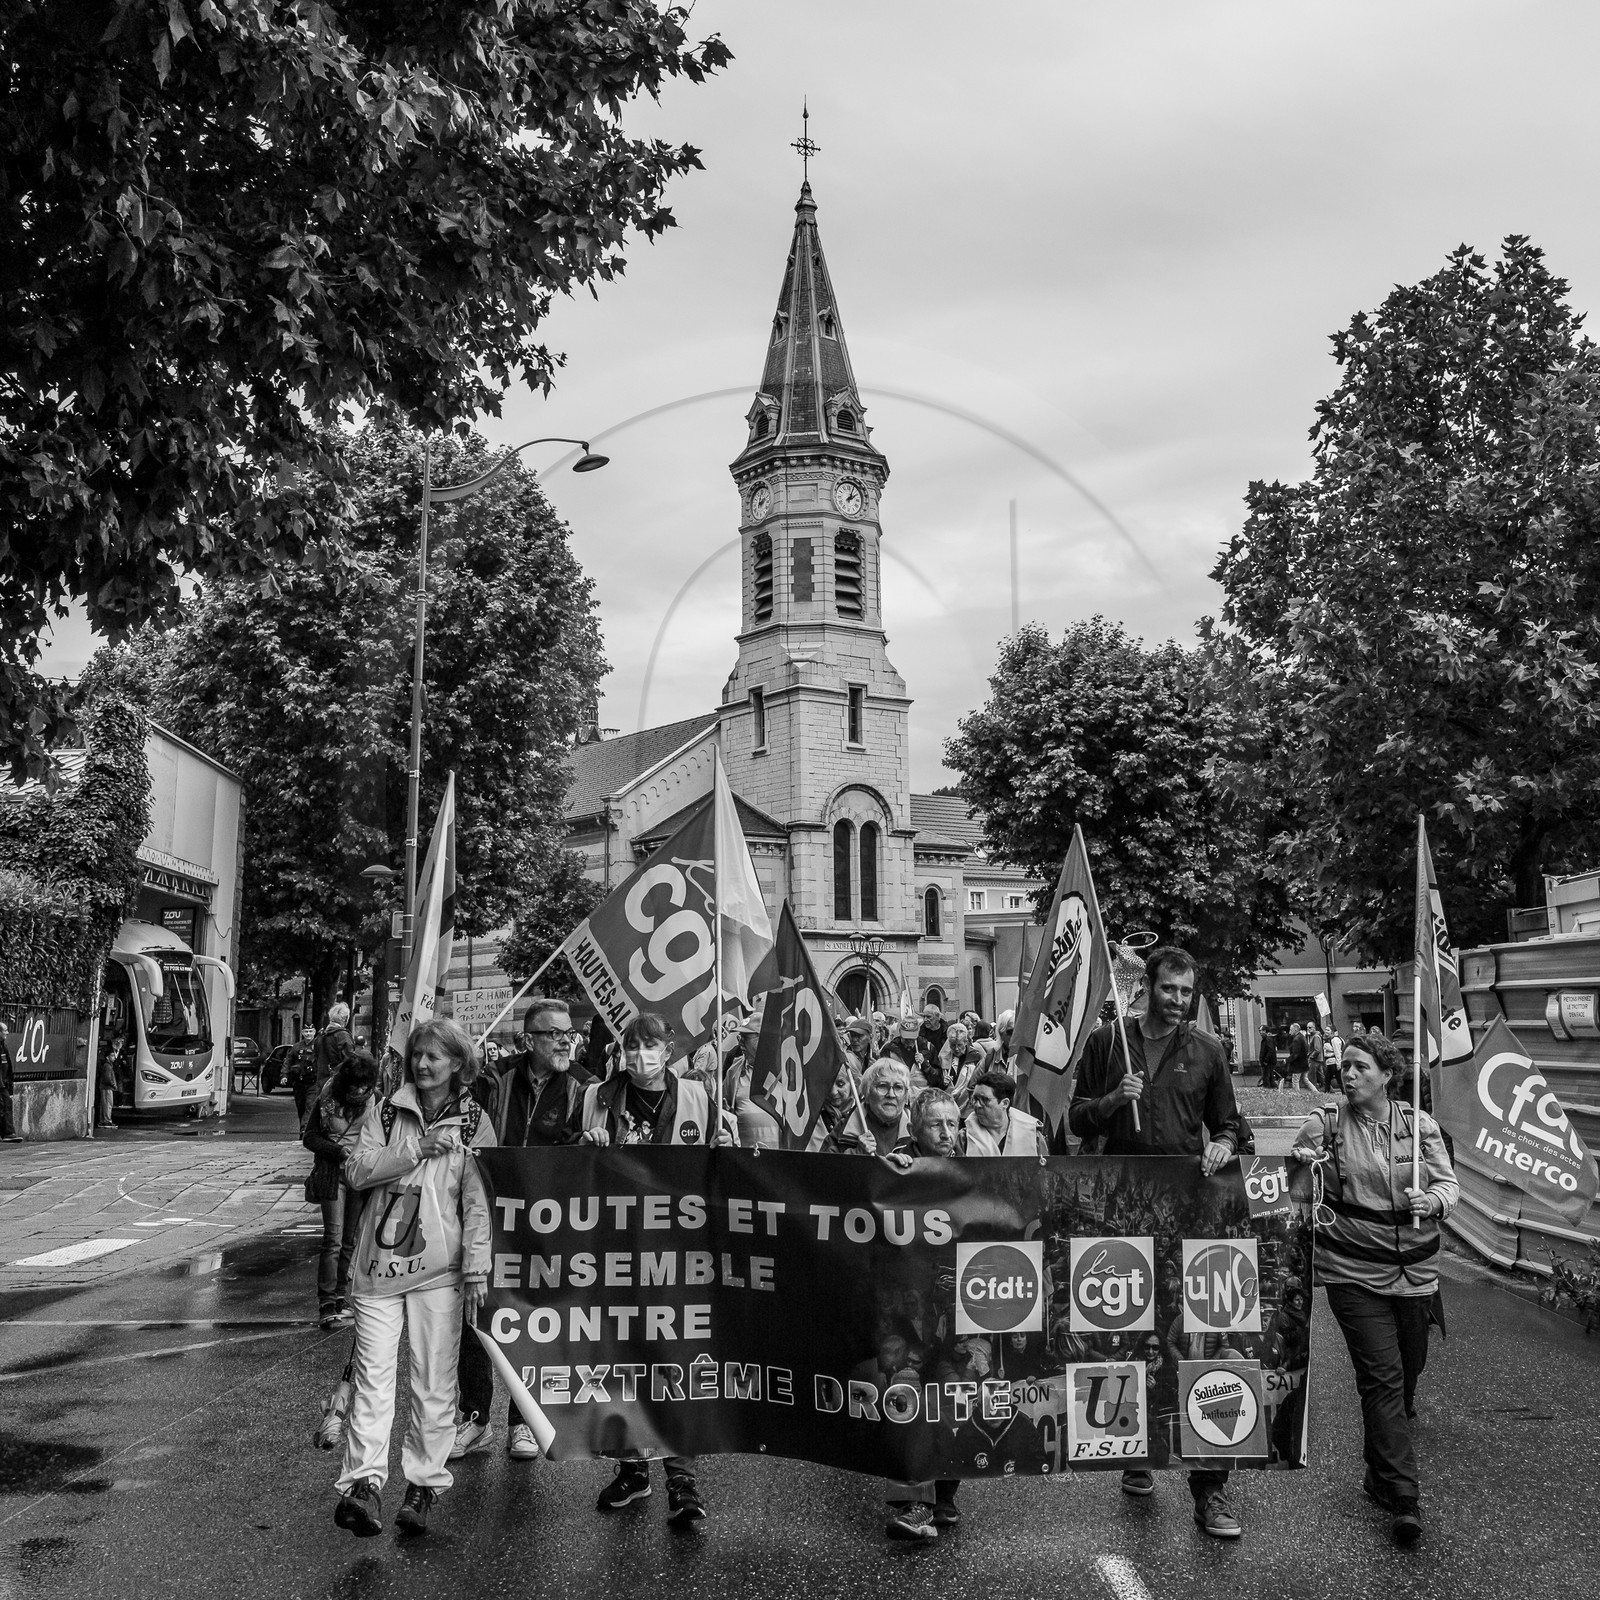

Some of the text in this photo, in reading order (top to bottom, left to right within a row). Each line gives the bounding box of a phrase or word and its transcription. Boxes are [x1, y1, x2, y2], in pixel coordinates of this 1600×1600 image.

[456, 993, 471, 1004] LE
[571, 936, 632, 1037] HAUTES-AL
[16, 1016, 50, 1064] d'Or
[1475, 1127, 1578, 1192] Interco
[1501, 1126, 1517, 1139] des
[1542, 1145, 1559, 1157] des
[1559, 1154, 1582, 1170] actes
[1244, 1166, 1290, 1204] cgt
[495, 1194, 953, 1246] TOUTES ET TOUS
[366, 1257, 426, 1278] F.S.U.
[493, 1251, 776, 1292] ENSEMBLE
[1082, 1249, 1144, 1278] la
[965, 1276, 1033, 1300] Cfdt:
[1078, 1268, 1144, 1317] cgt
[490, 1304, 712, 1344] CONTRE
[521, 1353, 1013, 1424] 'EXTRÊME DROITE
[1194, 1381, 1242, 1401] Solidaires
[1201, 1408, 1246, 1421] Antifasciste
[1073, 1440, 1146, 1458] F.S.U.
